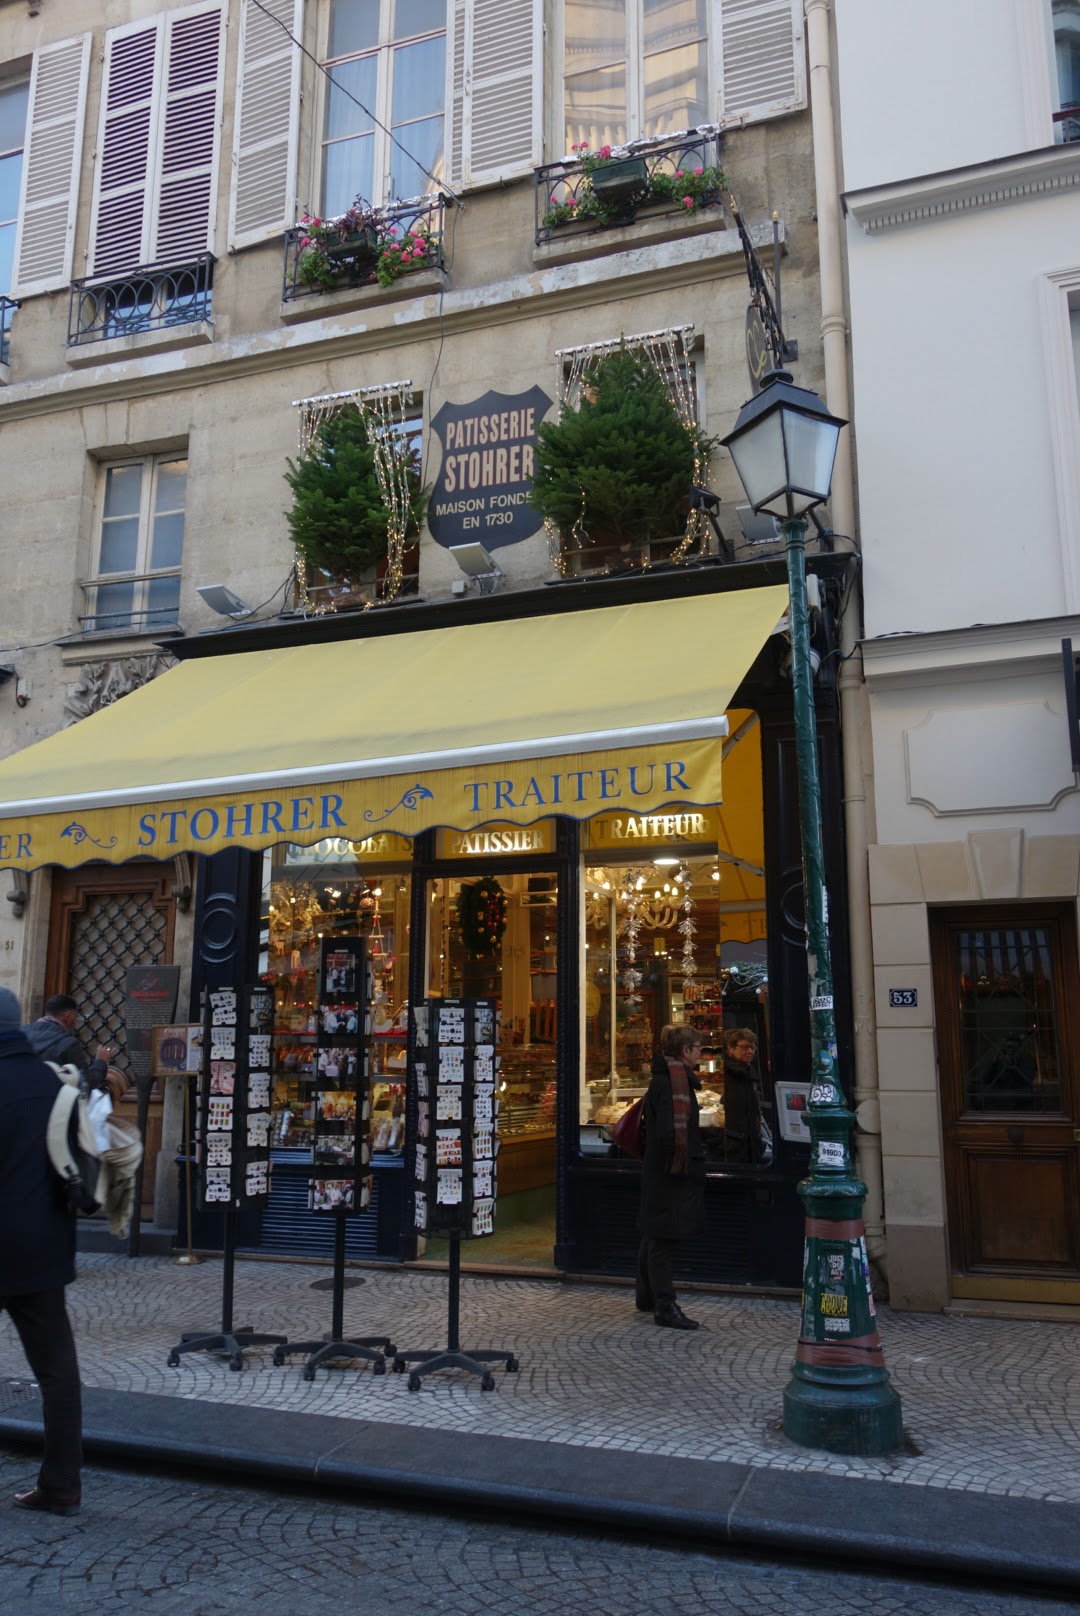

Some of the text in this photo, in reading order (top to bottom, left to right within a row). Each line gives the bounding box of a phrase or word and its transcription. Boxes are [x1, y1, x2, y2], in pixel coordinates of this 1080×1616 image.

[446, 408, 535, 450] PATISSERIE
[445, 444, 534, 492] STOHRER
[436, 498, 485, 516] MAISON
[463, 511, 513, 529] EN 1730
[464, 761, 691, 812] TRAITEUR
[138, 794, 347, 847] STOHRER
[596, 813, 706, 840] TRAITEUR
[451, 829, 545, 853] PATISSIER
[5, 940, 14, 950] 51
[893, 992, 912, 1004] 53
